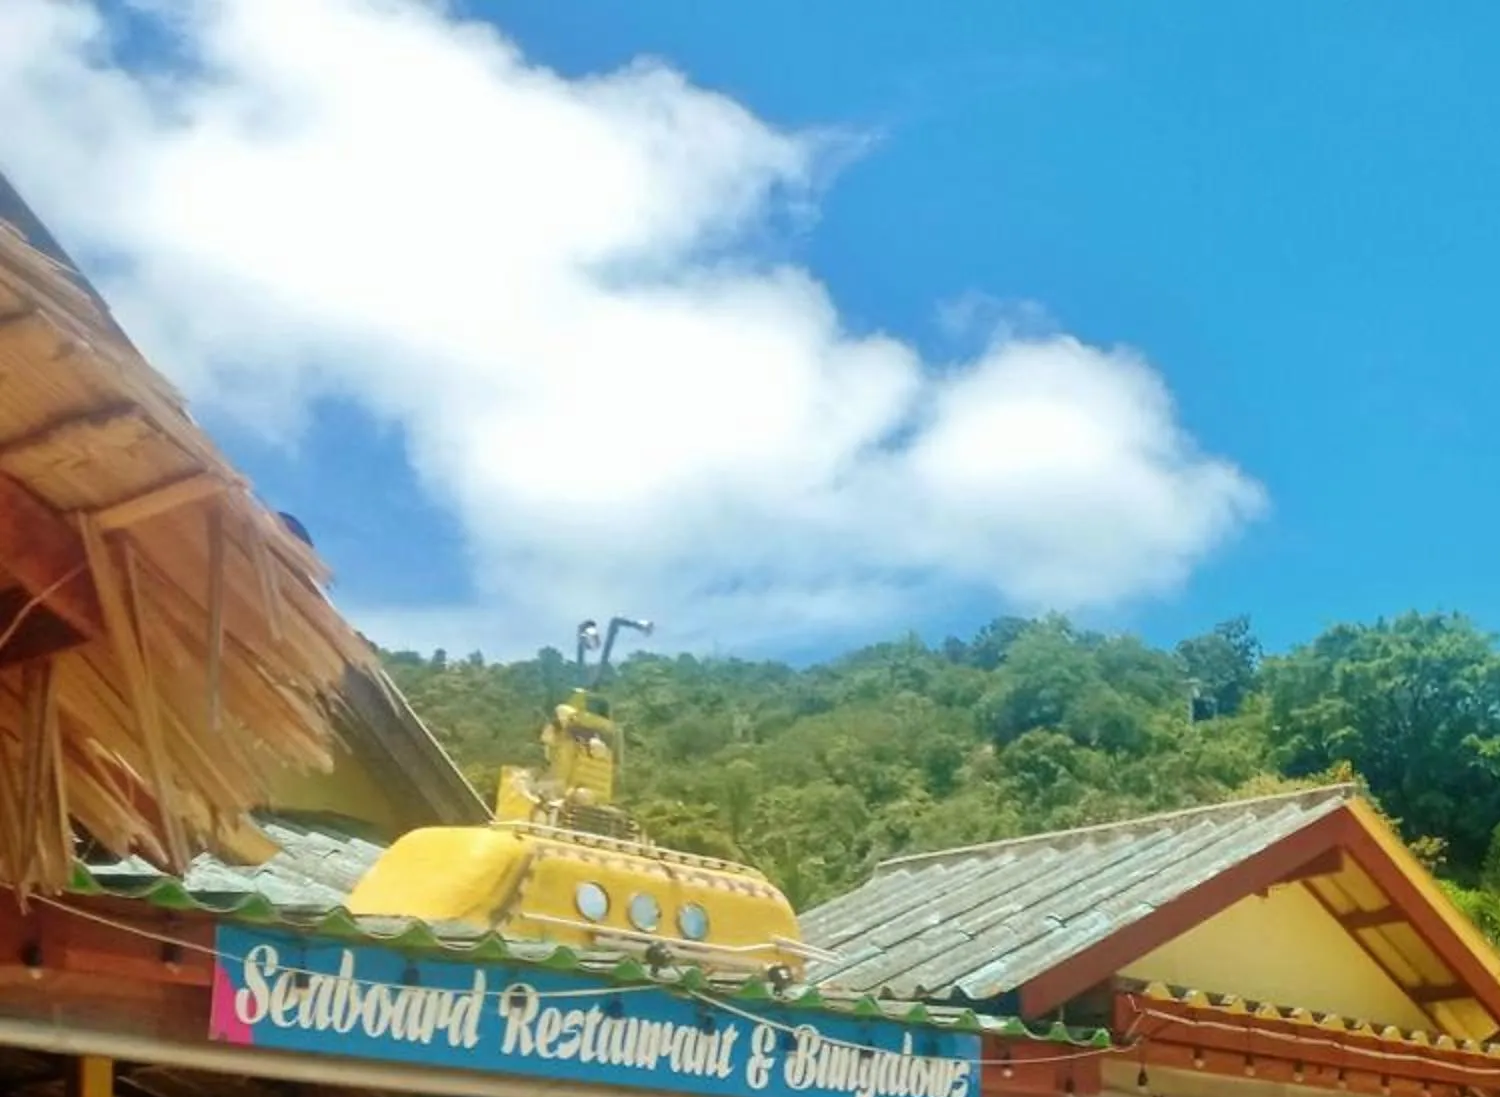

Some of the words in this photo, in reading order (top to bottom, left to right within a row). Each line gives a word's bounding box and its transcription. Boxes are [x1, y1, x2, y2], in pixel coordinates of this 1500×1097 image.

[235, 944, 484, 1049] Seaboard
[499, 983, 737, 1079] Restaurant
[745, 1024, 775, 1090] &
